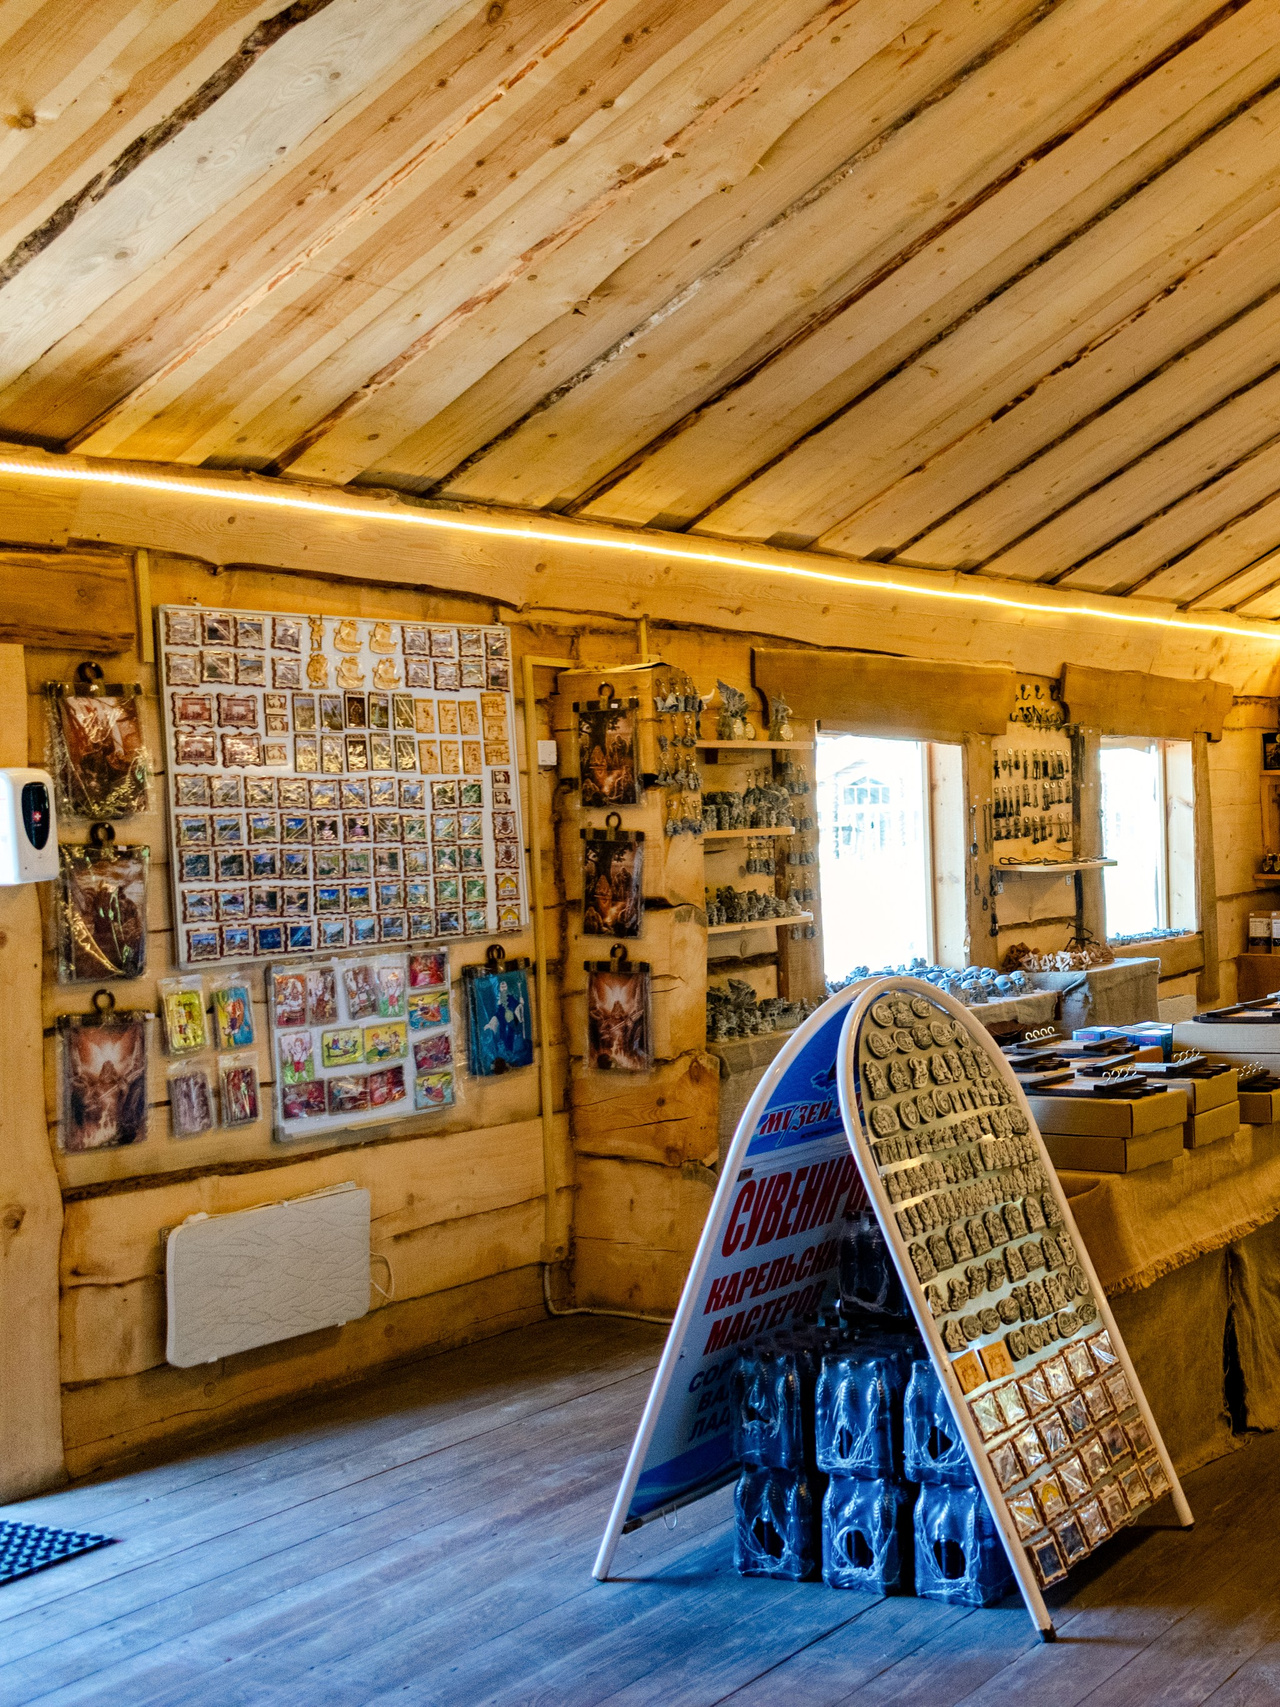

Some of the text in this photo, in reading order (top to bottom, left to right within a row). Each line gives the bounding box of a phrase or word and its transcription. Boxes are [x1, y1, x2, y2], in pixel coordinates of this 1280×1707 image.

[760, 1095, 834, 1147] МУЗЕЙ
[721, 1155, 869, 1257] СУВЕНИРЫ
[703, 1239, 840, 1314] КАРЕЛЬСКИ
[703, 1280, 827, 1355] МАСТЕРОВ
[690, 1358, 735, 1390] СОР
[698, 1386, 730, 1413] ВА
[689, 1407, 731, 1441] ЛАД
